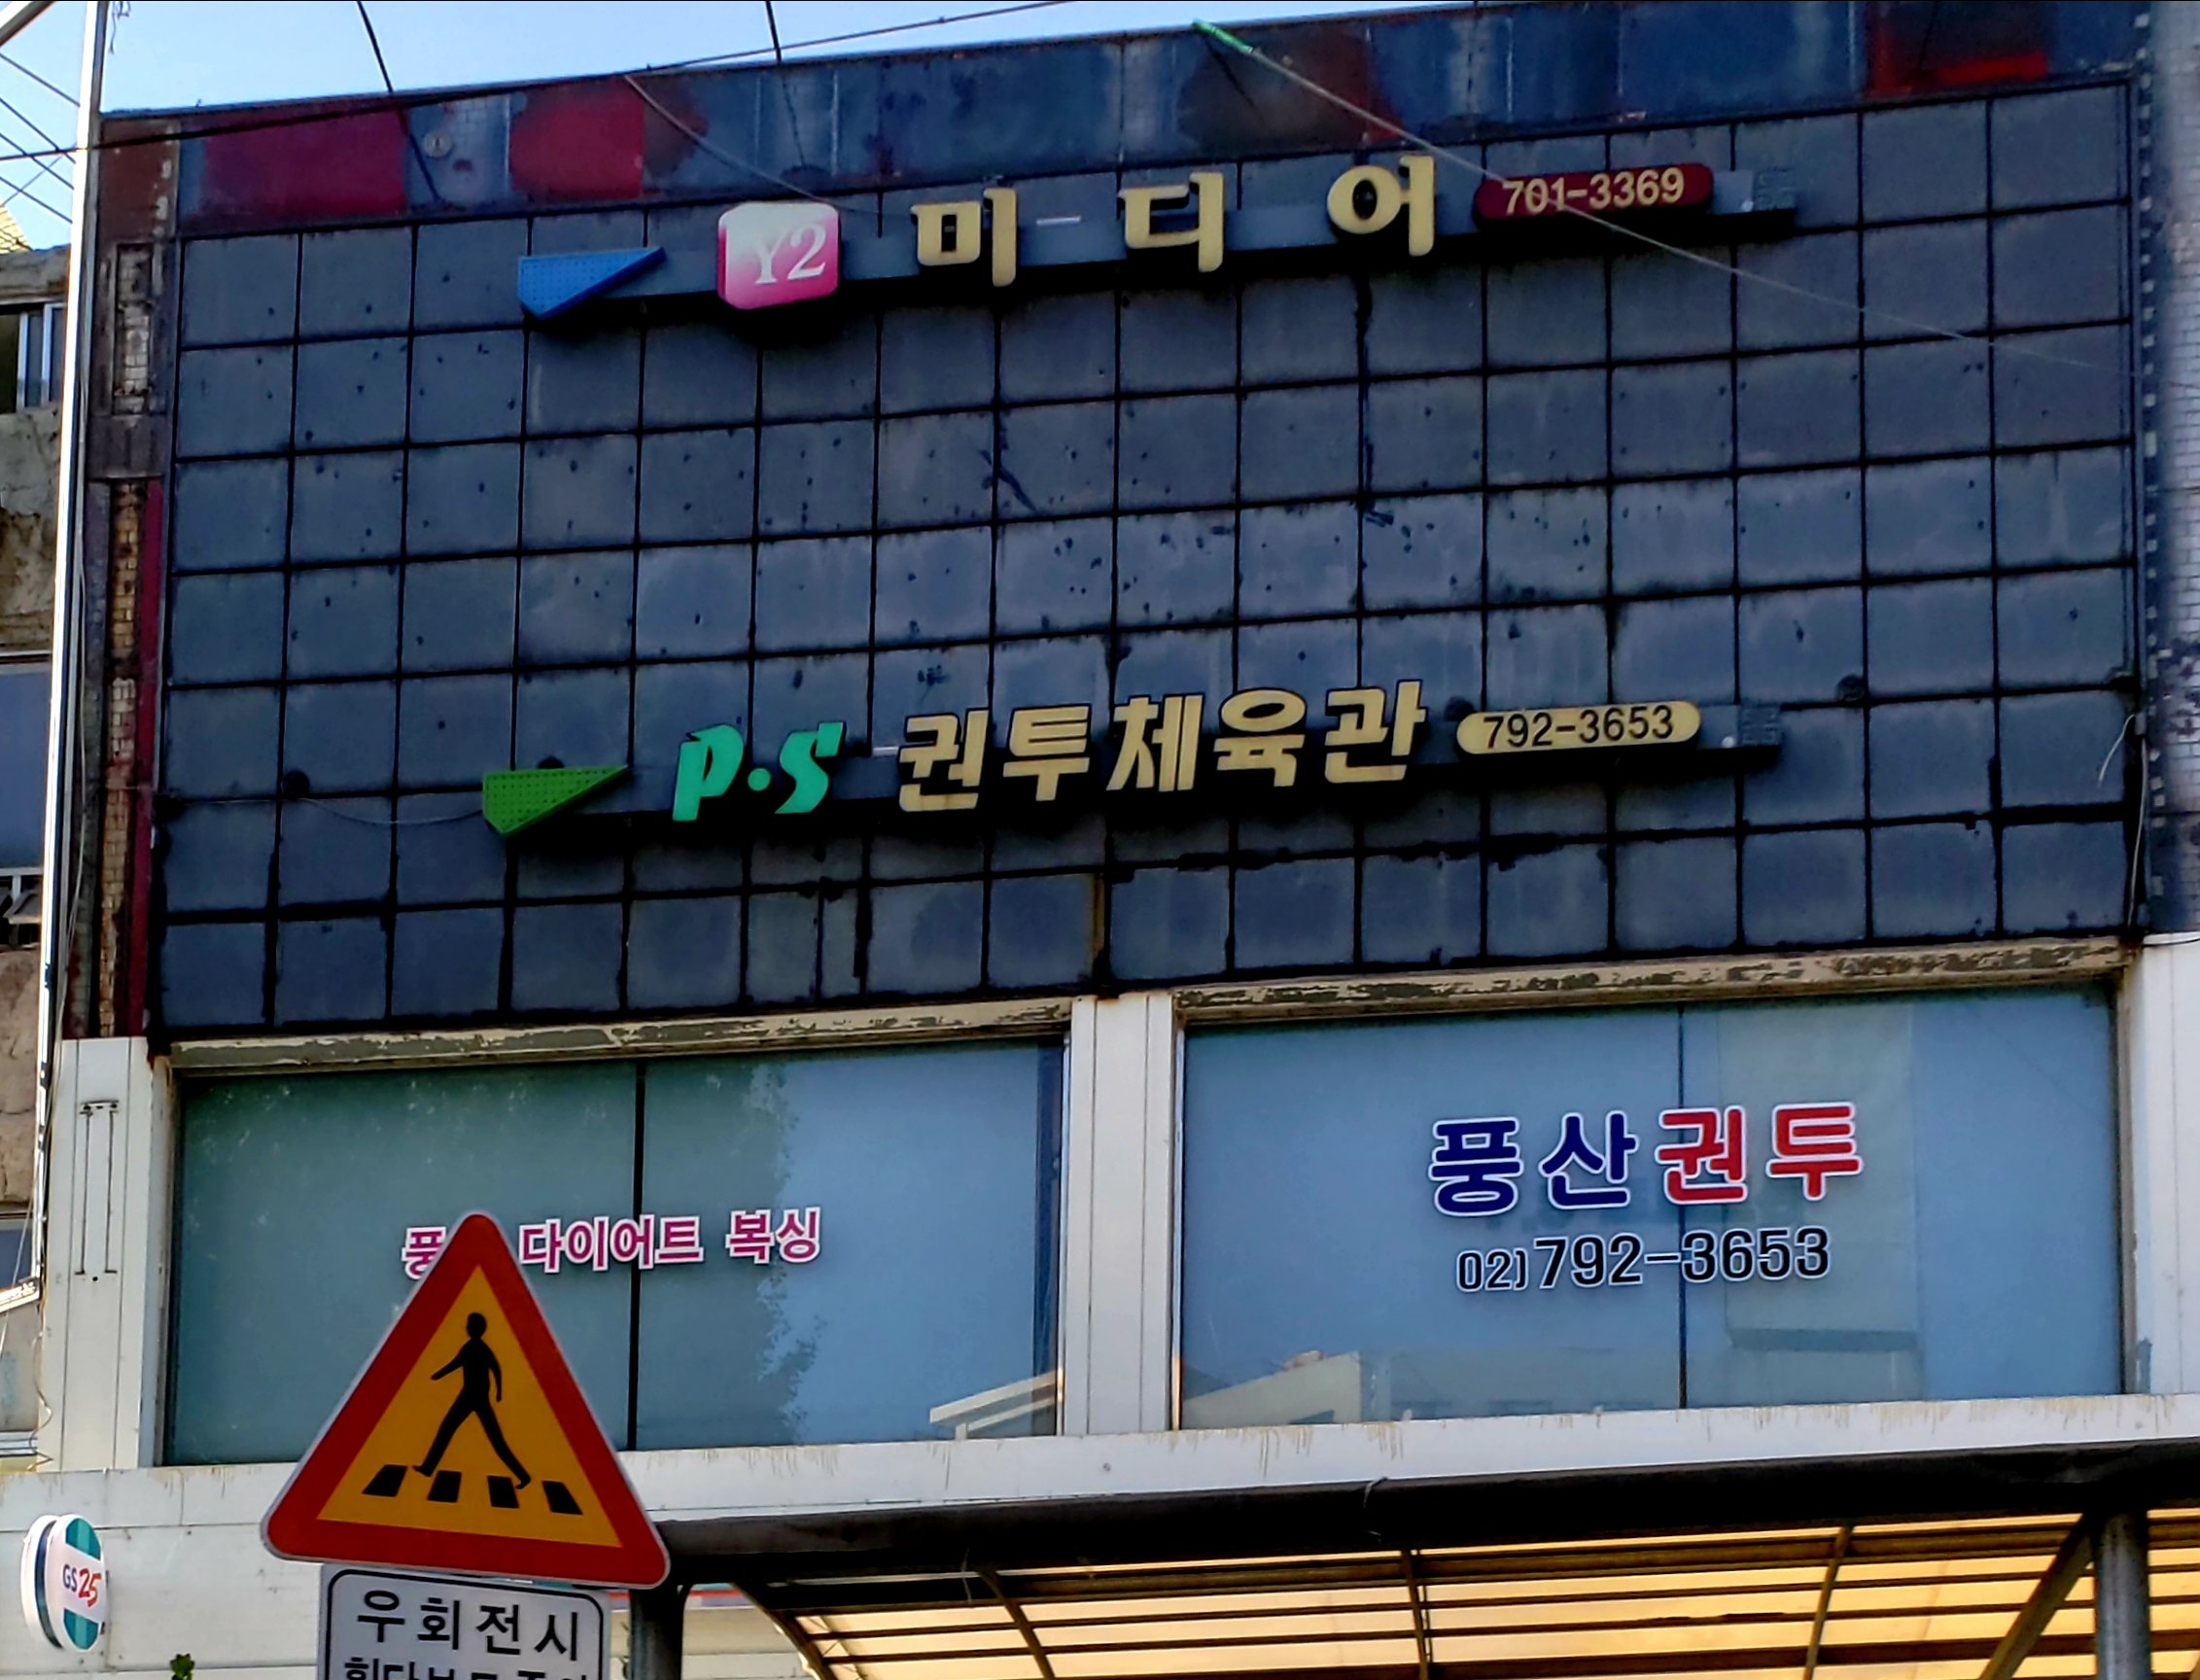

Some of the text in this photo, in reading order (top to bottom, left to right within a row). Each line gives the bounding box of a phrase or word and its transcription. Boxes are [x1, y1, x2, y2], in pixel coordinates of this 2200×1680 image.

[754, 156, 1684, 288] Y2 미디어 701-3369
[897, 680, 1427, 813] 권투체육관
[1483, 705, 1675, 751] 792-3653
[402, 1207, 821, 1280] 풍 다이어트 복싱
[62, 1563, 102, 1608] GS25
[357, 1590, 579, 1662] 우회전시
